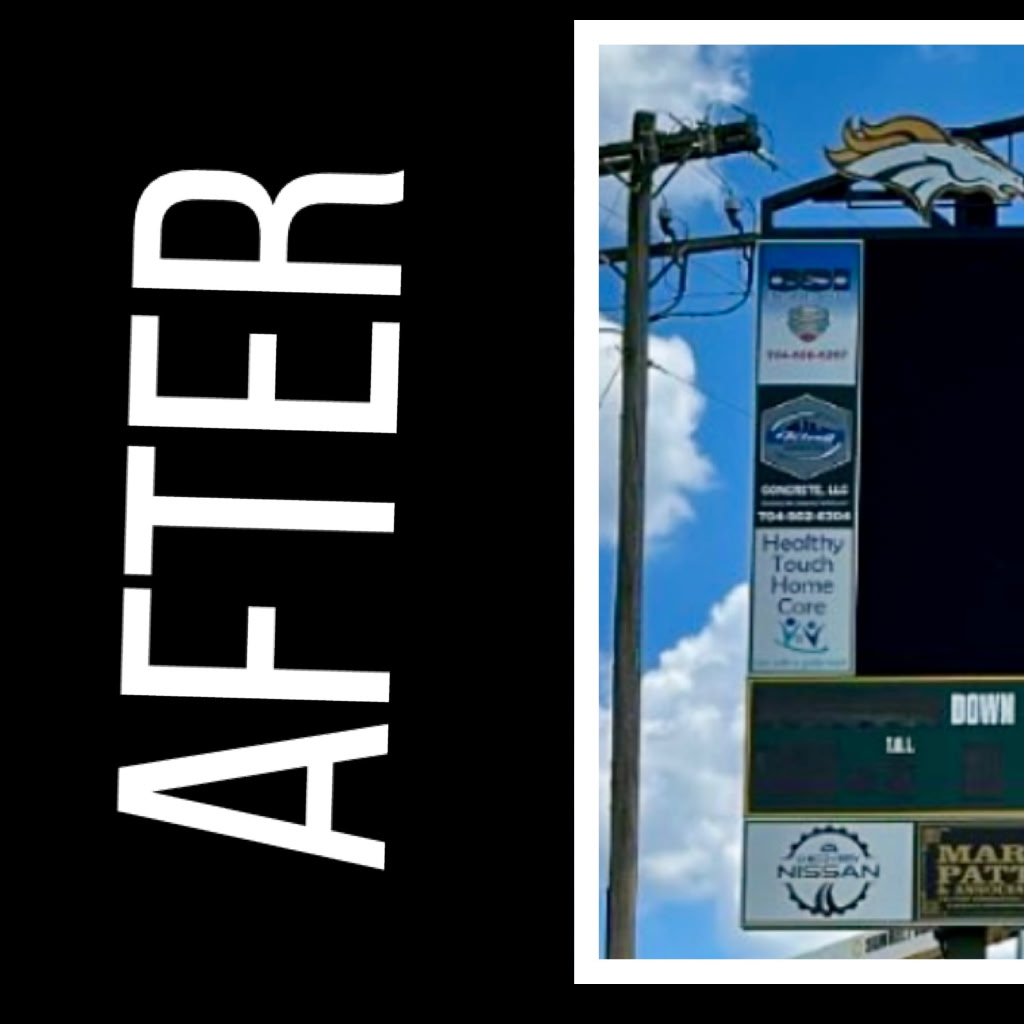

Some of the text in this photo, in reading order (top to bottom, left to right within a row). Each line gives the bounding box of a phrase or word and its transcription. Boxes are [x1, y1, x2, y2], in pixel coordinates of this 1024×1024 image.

[762, 533, 845, 555] Healthy
[774, 555, 834, 573] Touch
[770, 576, 835, 594] Home
[950, 693, 1015, 726] DOWN
[777, 863, 880, 878] NISSAN
